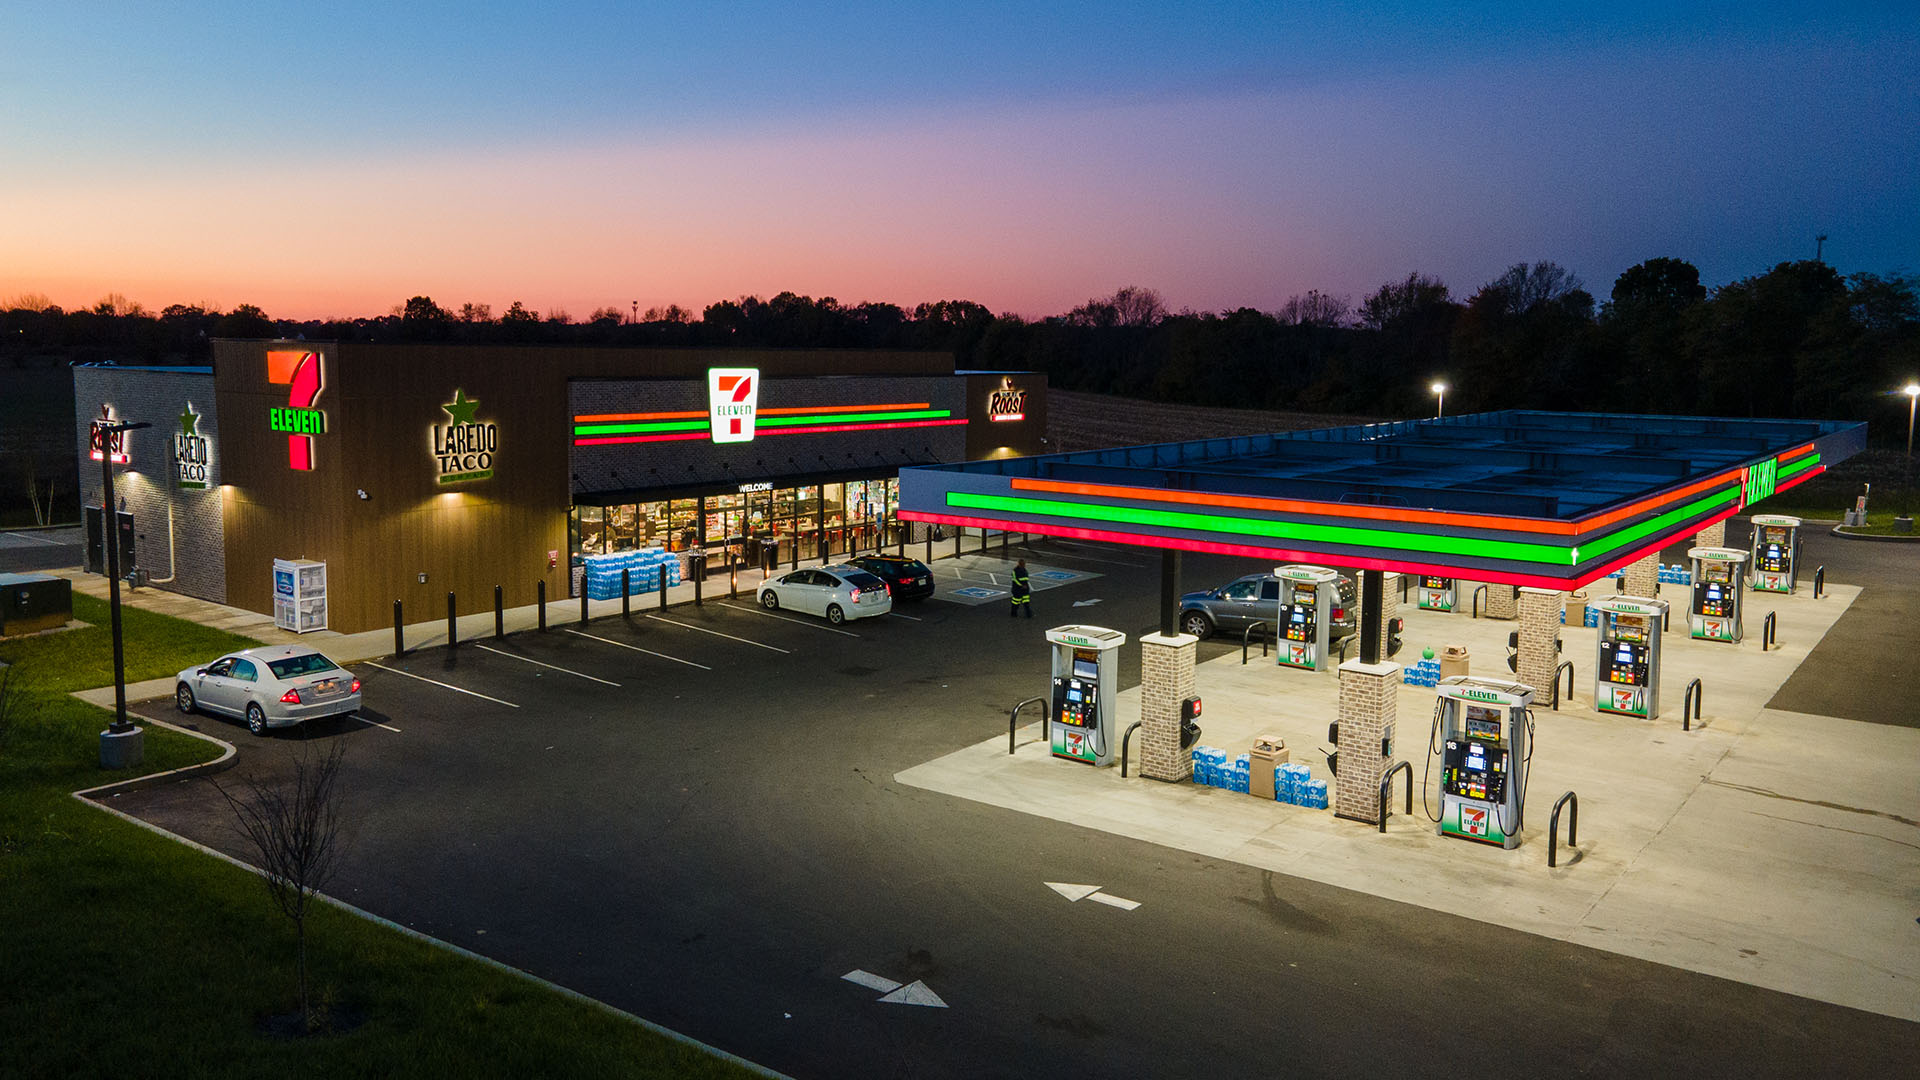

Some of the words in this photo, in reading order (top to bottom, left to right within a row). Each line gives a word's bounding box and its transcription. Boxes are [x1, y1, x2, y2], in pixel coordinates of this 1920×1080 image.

[991, 392, 1027, 414] ROOST
[173, 433, 207, 466] LAREDO
[434, 424, 497, 455] LAREDO
[176, 463, 205, 481] TACO
[438, 453, 492, 473] TACO
[739, 482, 773, 493] WELCOME
[1446, 741, 1457, 750] 16
